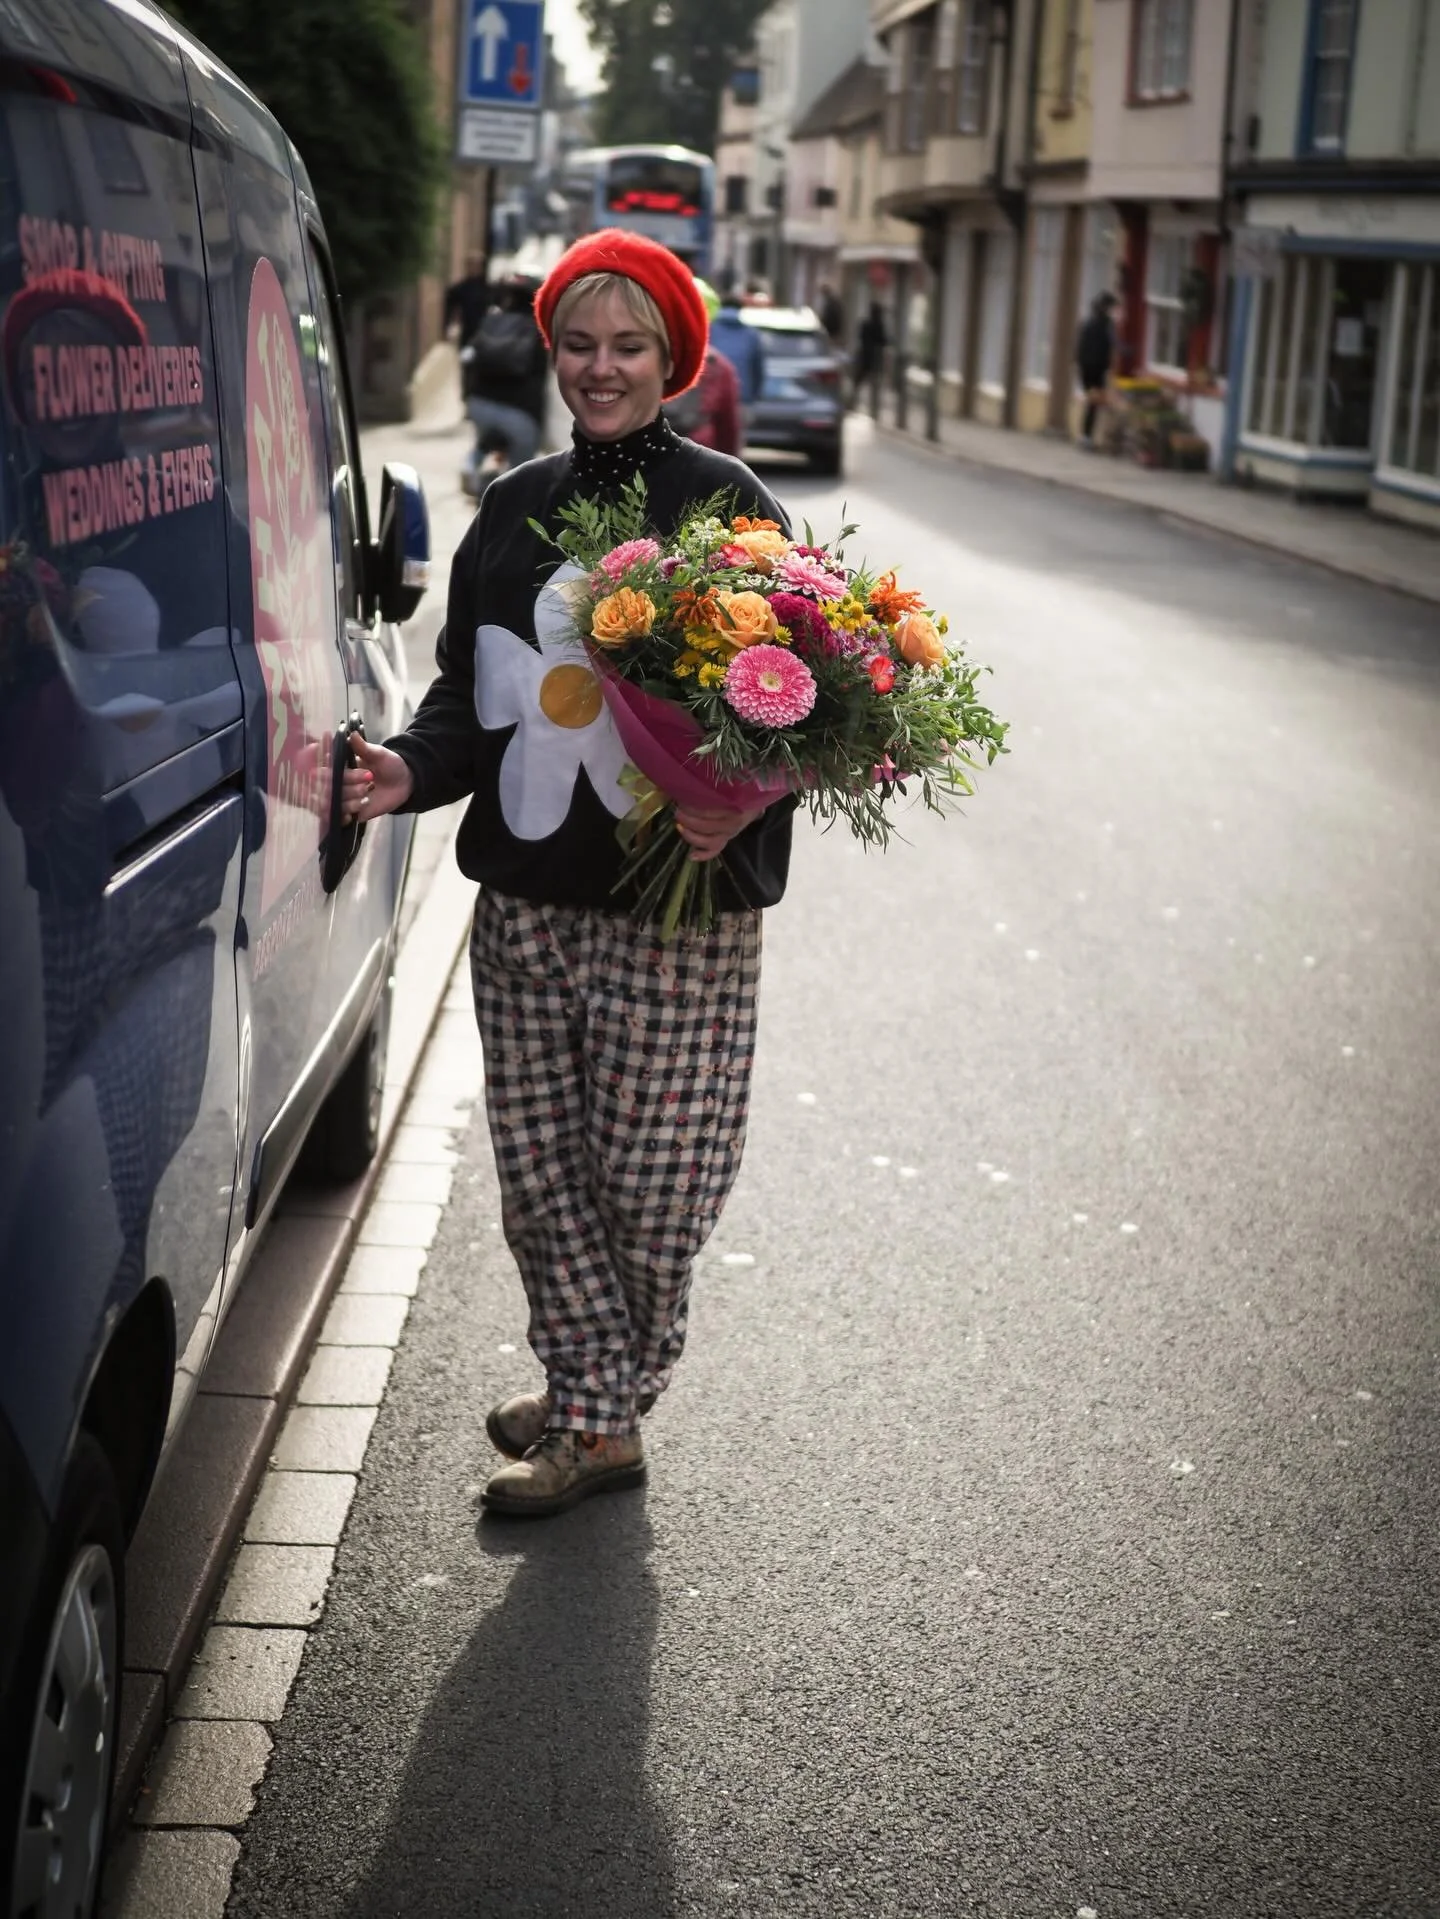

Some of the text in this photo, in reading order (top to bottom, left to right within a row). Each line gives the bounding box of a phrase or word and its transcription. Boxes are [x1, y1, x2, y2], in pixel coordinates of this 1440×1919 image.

[20, 214, 78, 294] SHOP
[102, 231, 166, 302] GIFTING
[33, 345, 203, 420] FLOWER DELIVERIES
[43, 444, 214, 546] WEDDINGS & EVENTS
